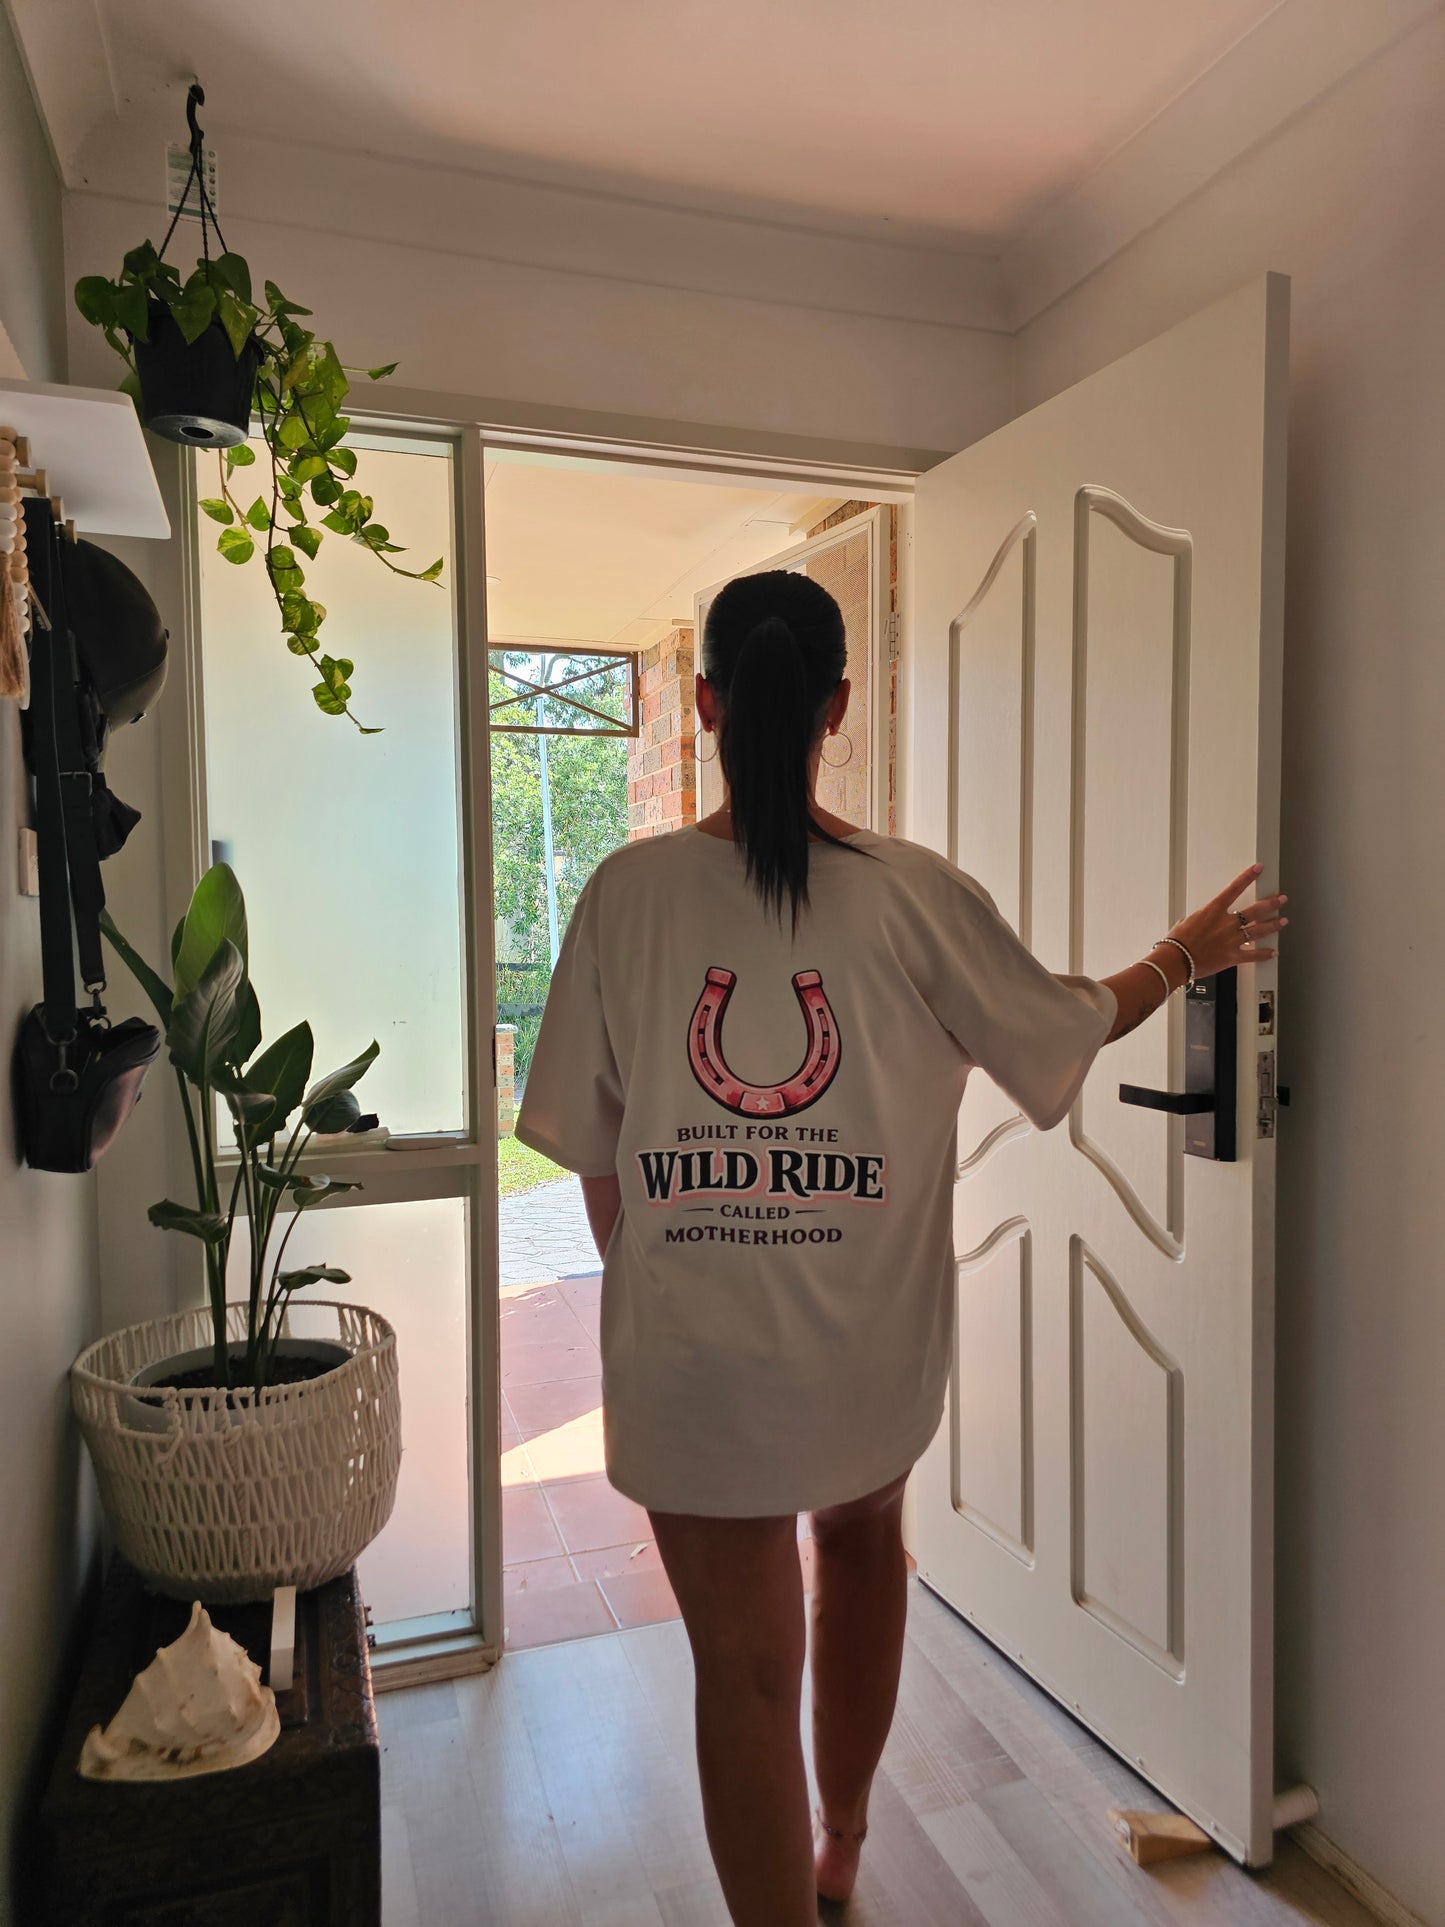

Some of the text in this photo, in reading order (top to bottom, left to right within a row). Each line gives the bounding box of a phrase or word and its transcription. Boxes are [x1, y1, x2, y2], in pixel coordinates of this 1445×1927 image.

[677, 1125, 838, 1143] BUILT FOR THE
[638, 1149, 884, 1200] WILD RIDE
[720, 1204, 790, 1219] CALLED
[665, 1225, 842, 1245] MOTHERHOOD
